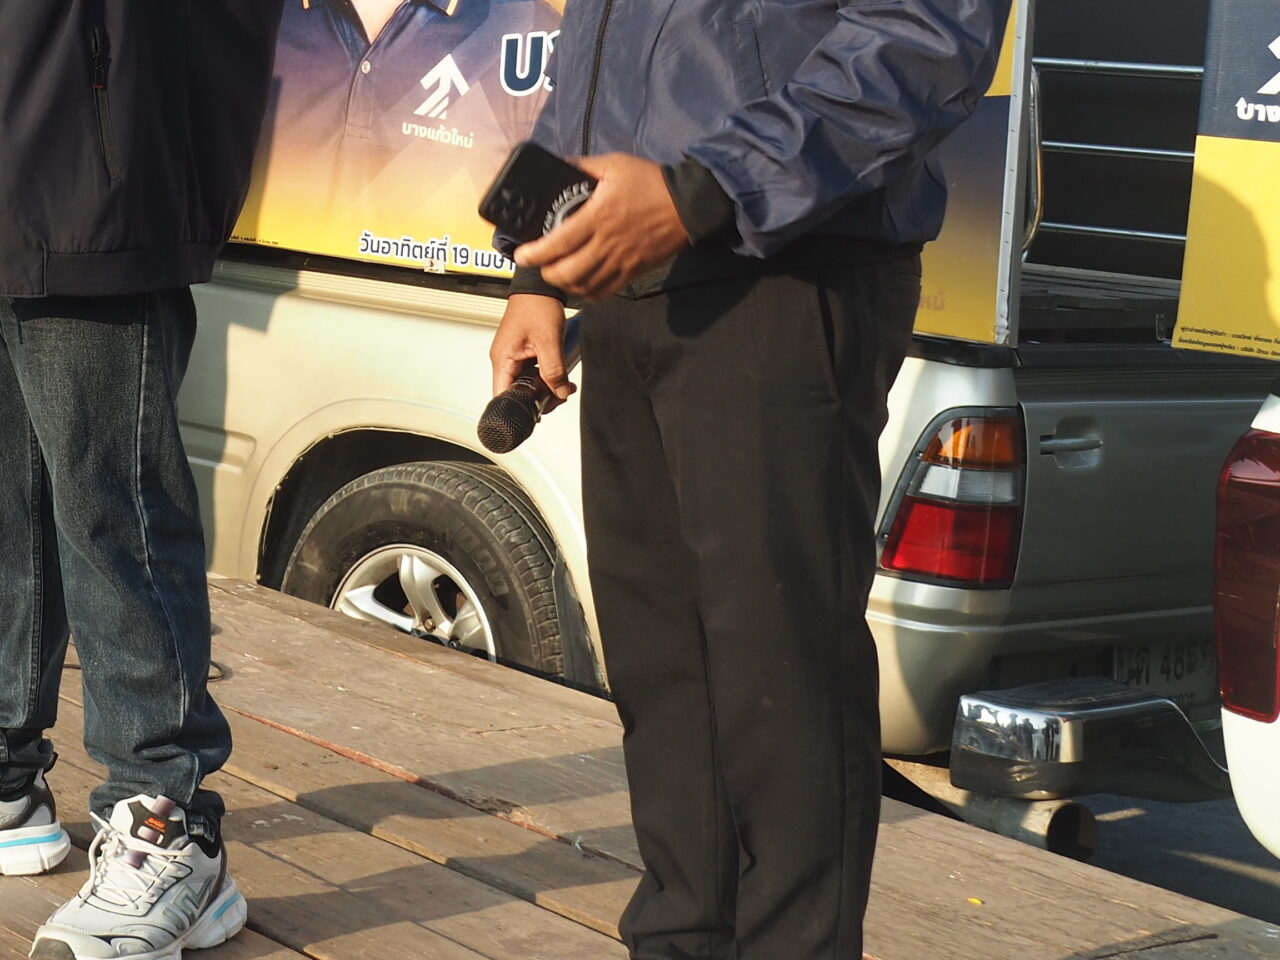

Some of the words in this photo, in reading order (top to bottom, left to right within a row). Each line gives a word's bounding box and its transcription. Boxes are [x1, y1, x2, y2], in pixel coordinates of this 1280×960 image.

[402, 122, 475, 149] บางแก้วใหม่
[360, 232, 448, 262] วันอาทิตย์ที่
[453, 246, 469, 265] 19
